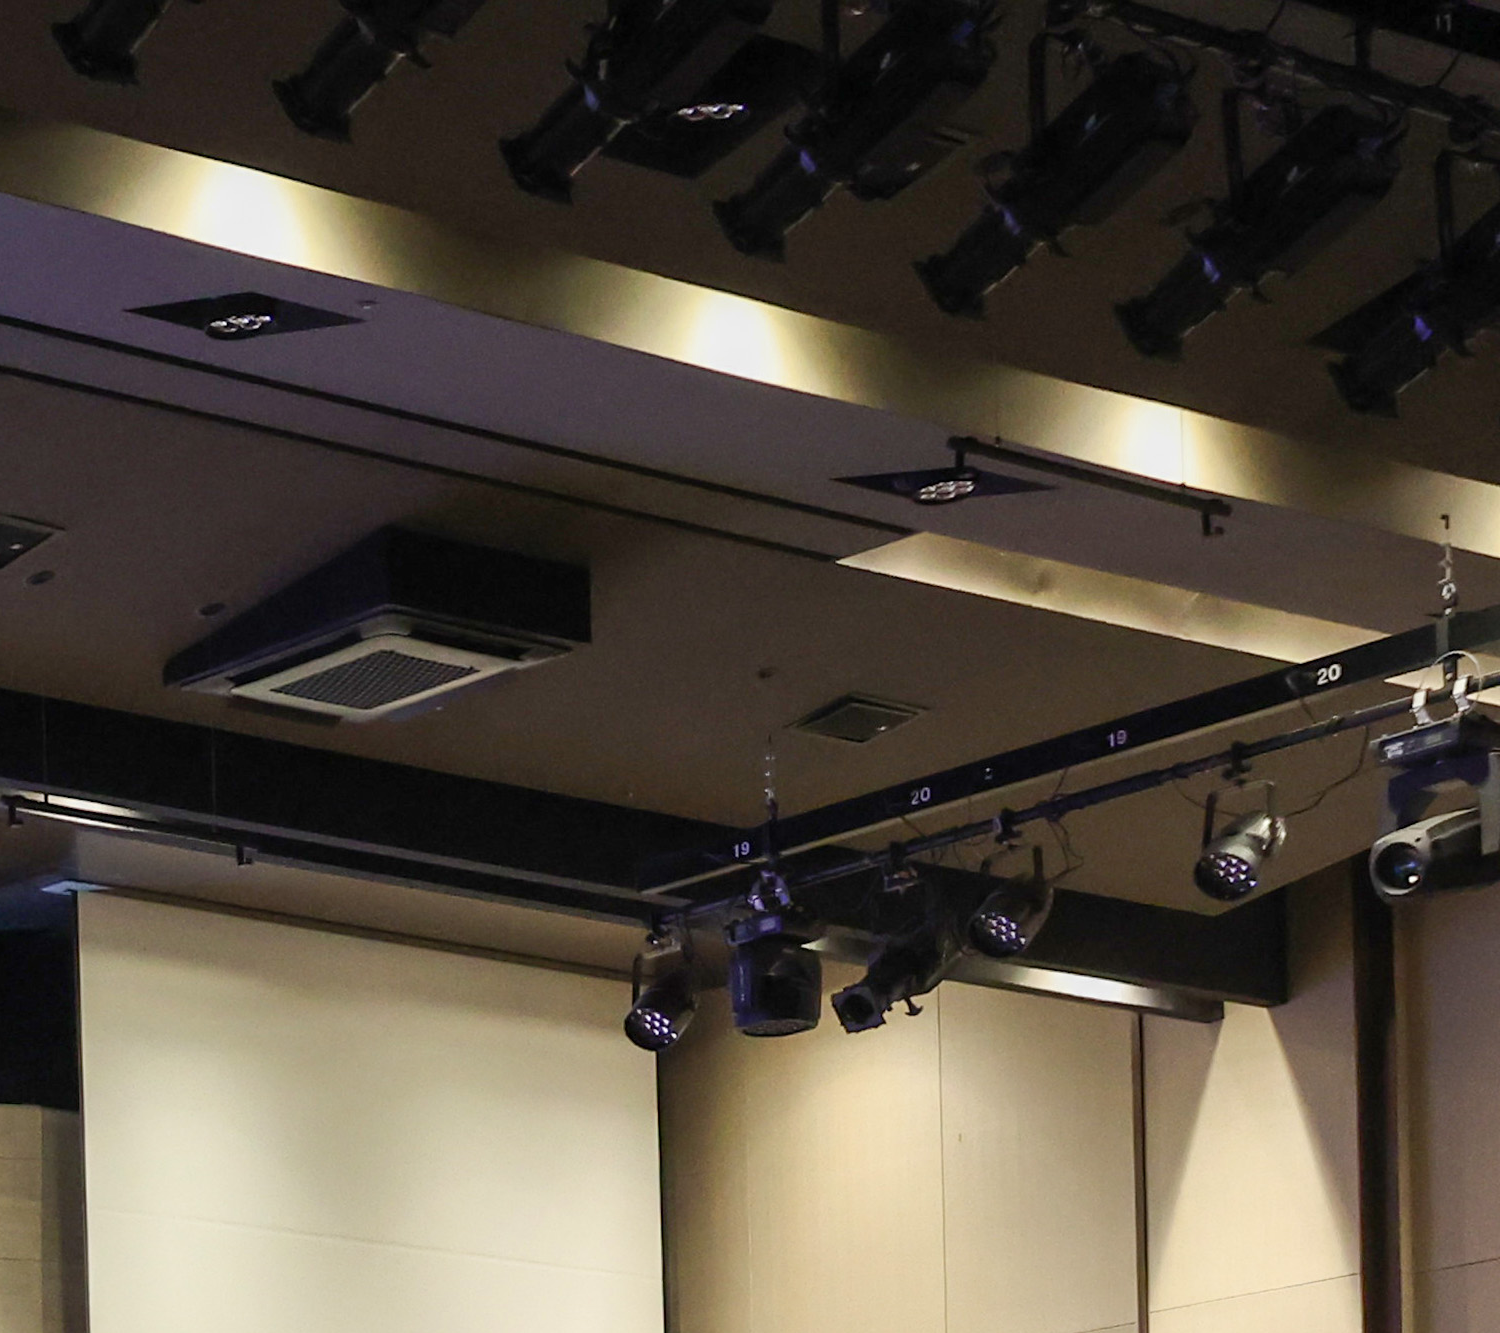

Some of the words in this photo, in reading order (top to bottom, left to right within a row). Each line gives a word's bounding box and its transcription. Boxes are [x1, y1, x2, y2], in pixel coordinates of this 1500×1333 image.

[1317, 664, 1342, 685] 20
[1108, 730, 1127, 747] 19
[911, 787, 930, 805] 20
[734, 841, 750, 858] 19
